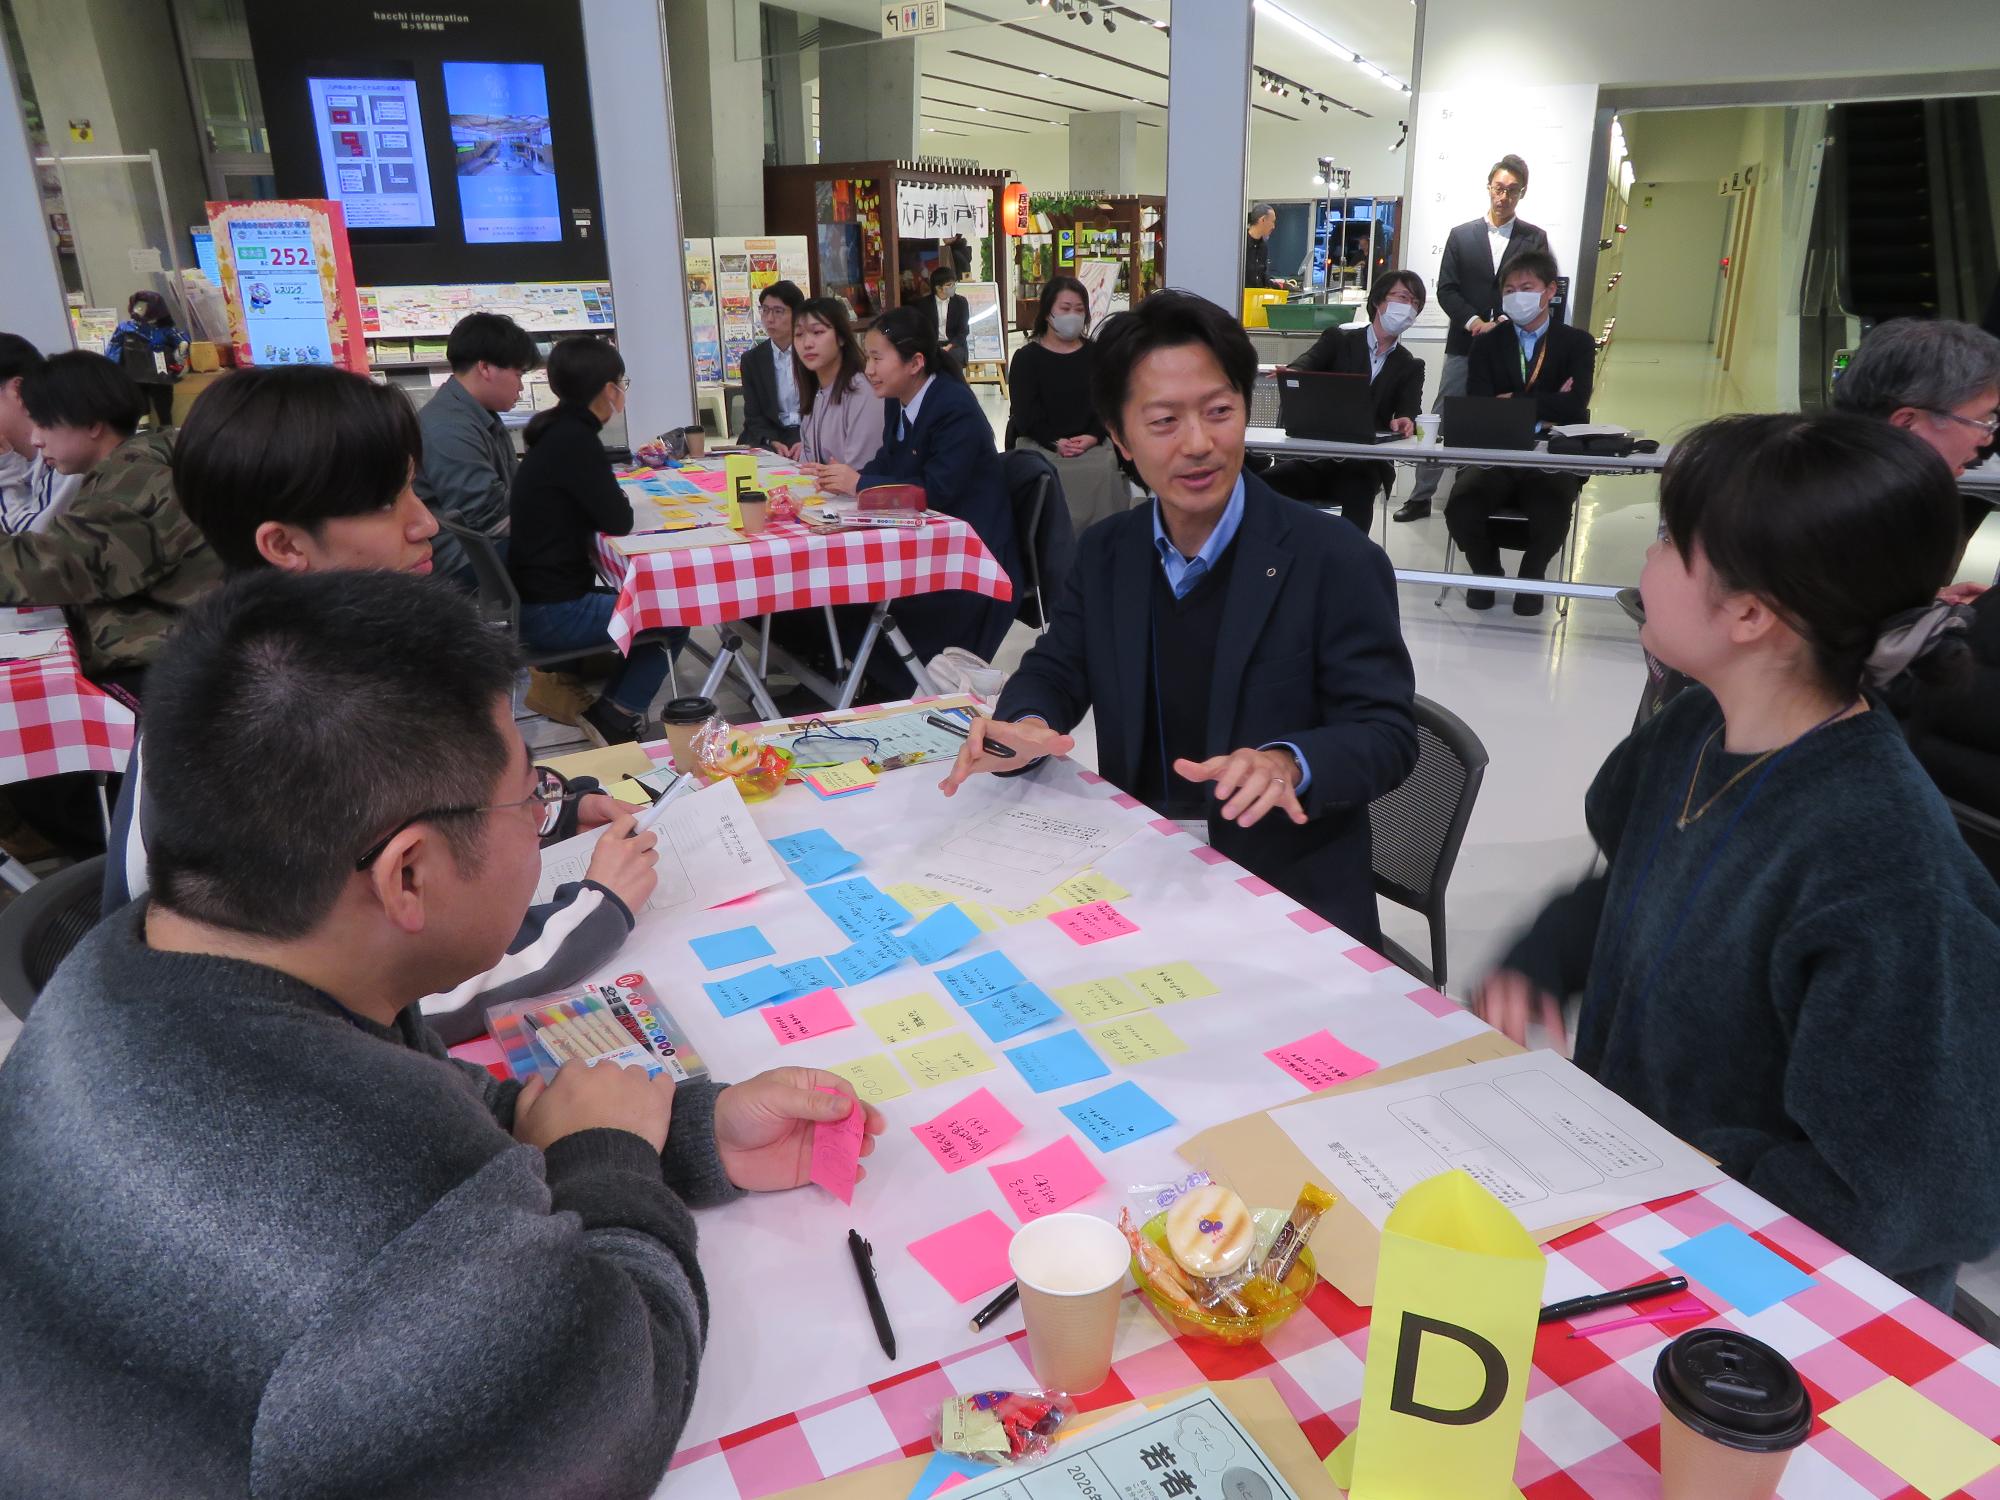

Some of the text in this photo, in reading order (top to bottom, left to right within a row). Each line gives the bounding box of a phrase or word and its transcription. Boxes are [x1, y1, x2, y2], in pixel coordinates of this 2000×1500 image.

[373, 11, 470, 23] hacchi information
[918, 154, 944, 166] ASAICHI
[951, 156, 980, 169] YOKOCHO
[1032, 189, 1105, 199] FOOD IN HACHINOHE
[1017, 192, 1029, 229] 居酒屋
[270, 247, 310, 266] 252
[1389, 1310, 1510, 1425] D
[1193, 1426, 1215, 1453] マチと
[1138, 1441, 1201, 1500] 若者
